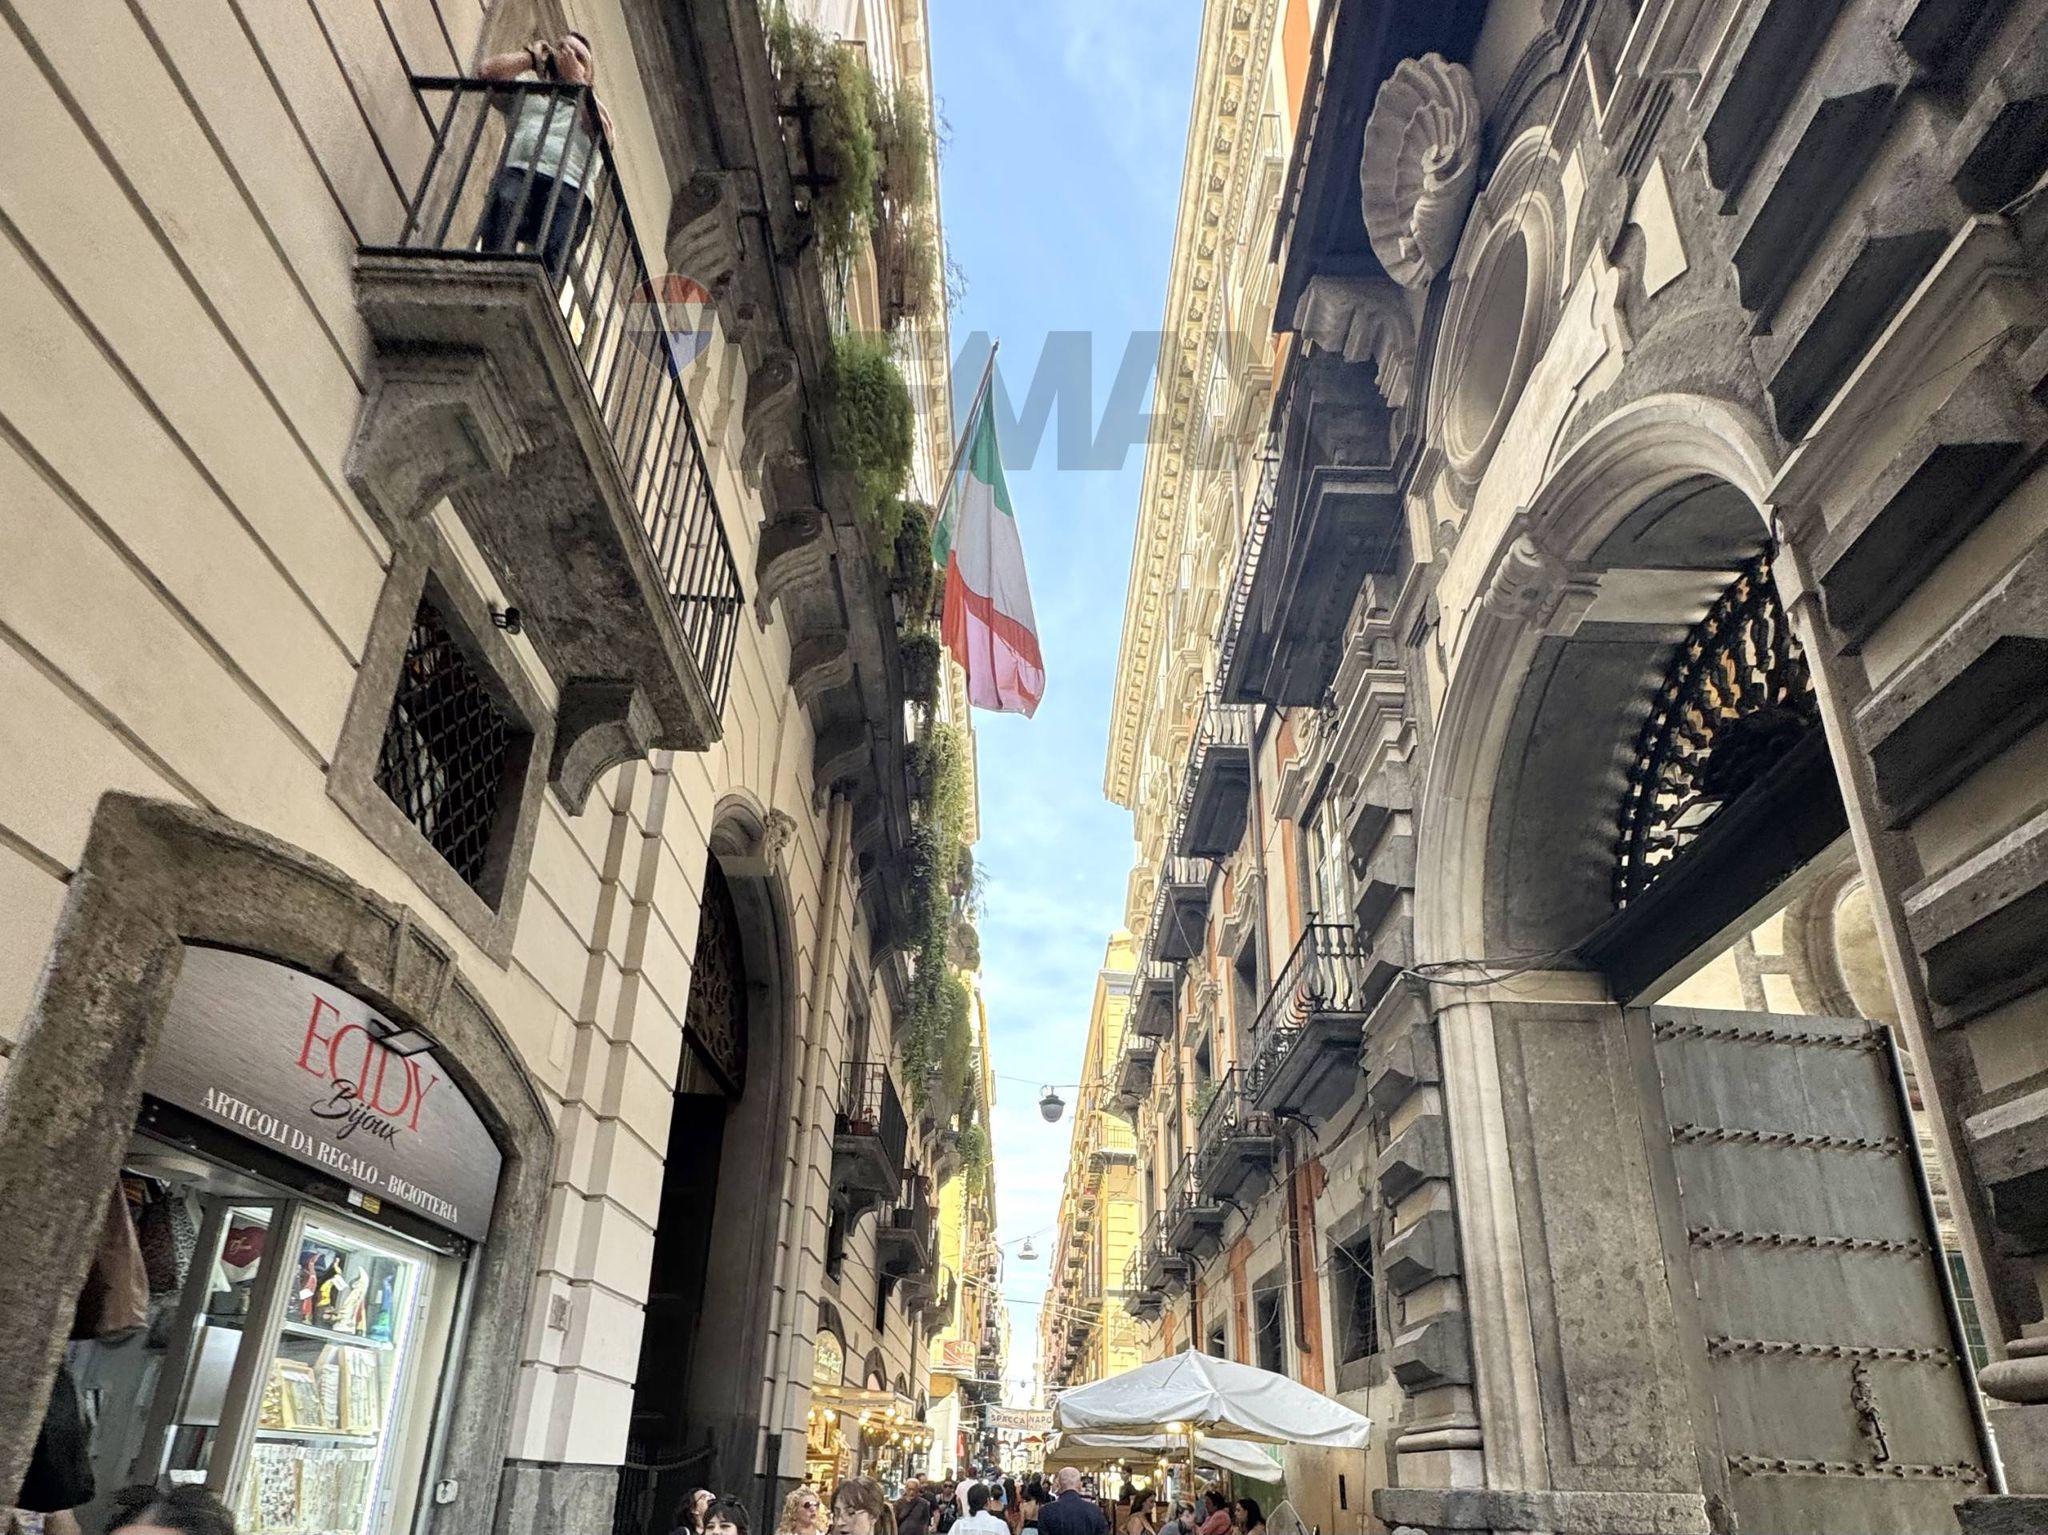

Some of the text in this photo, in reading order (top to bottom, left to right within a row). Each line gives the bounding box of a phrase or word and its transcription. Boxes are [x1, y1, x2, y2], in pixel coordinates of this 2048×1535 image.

[310, 1078, 401, 1151] Bijoux
[200, 1087, 289, 1144] ARTICOLI
[290, 1128, 313, 1156] DA
[317, 1141, 379, 1185] REGALO
[387, 1174, 458, 1224] BIGIOTTERIA
[991, 1414, 1026, 1425] SPACCA
